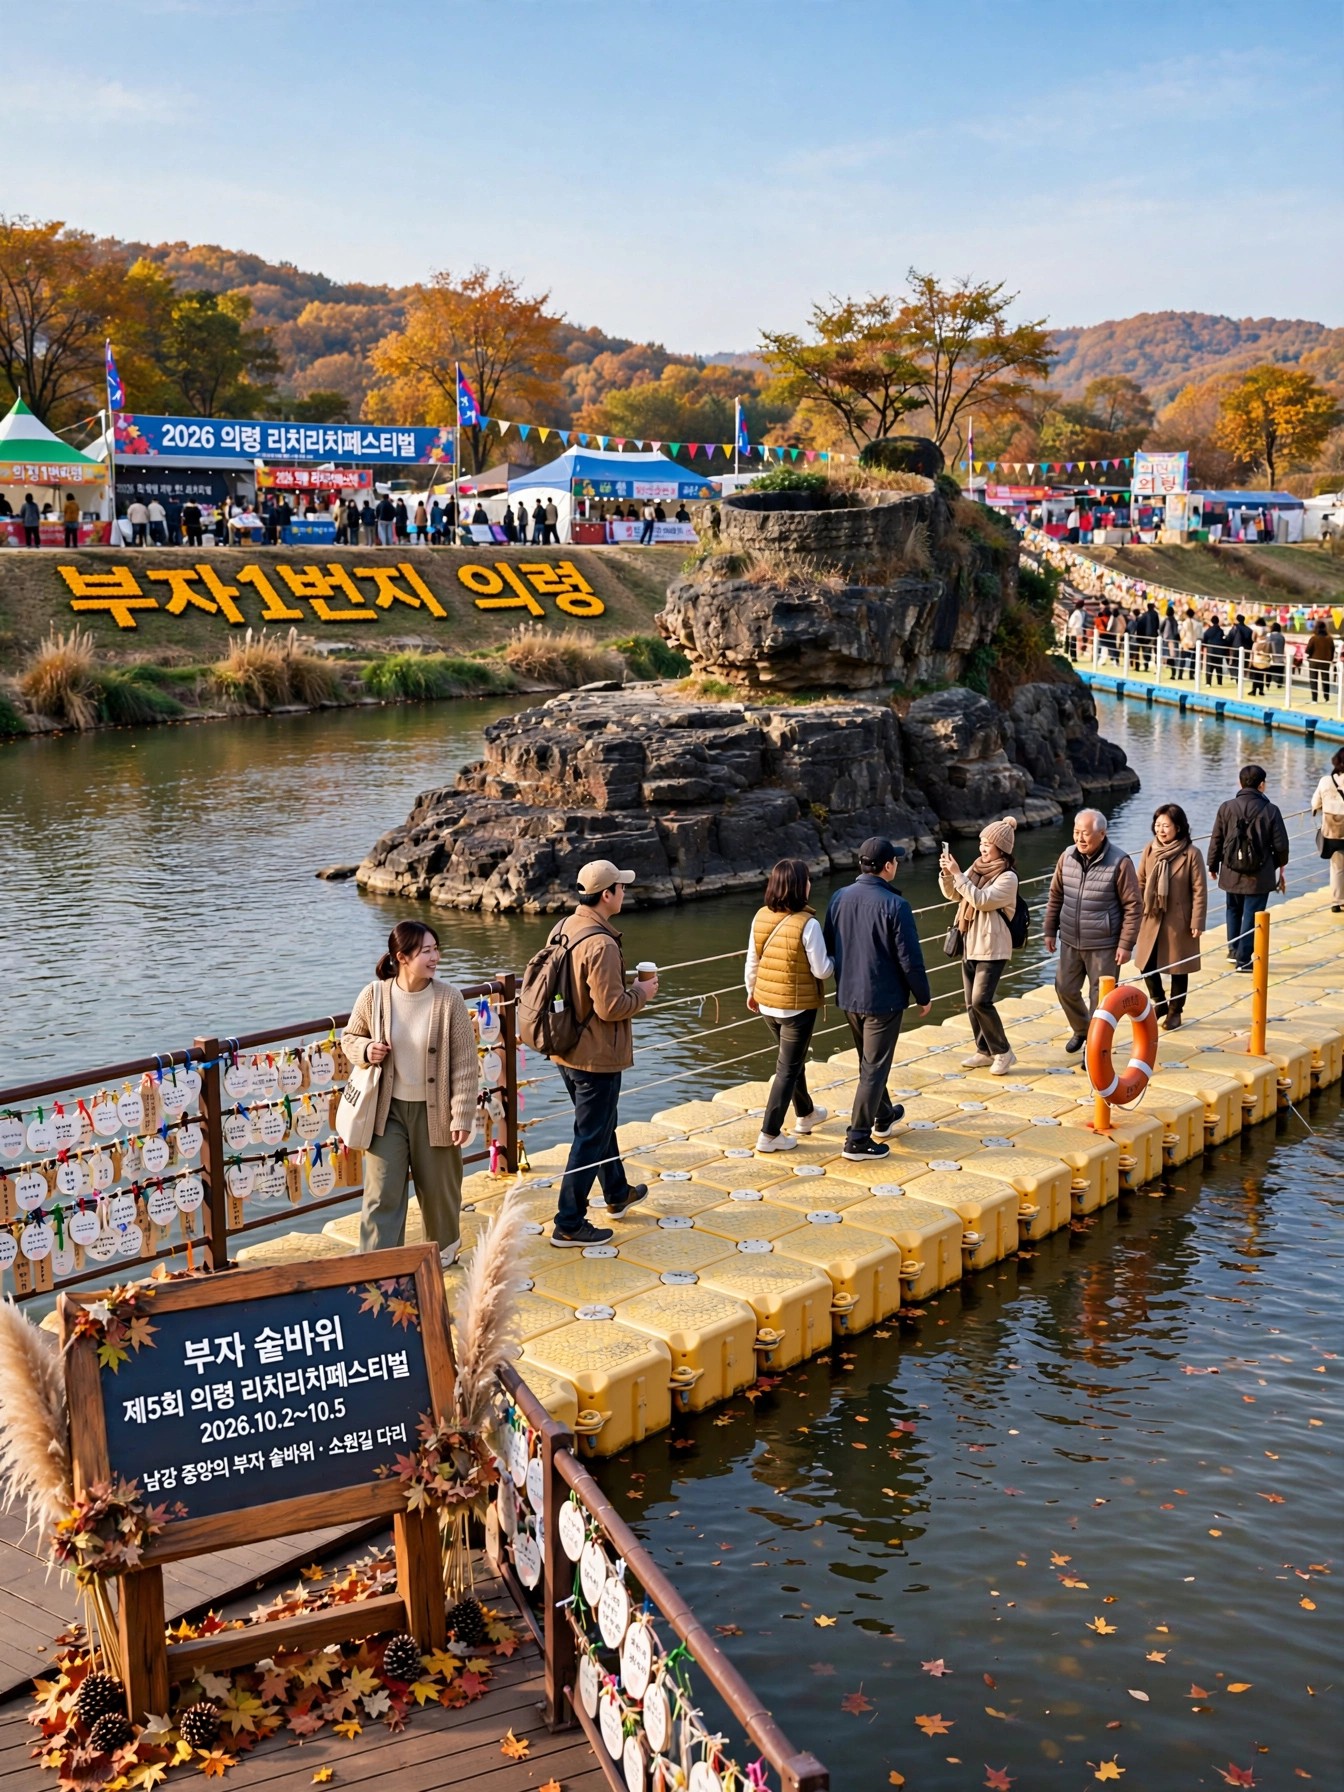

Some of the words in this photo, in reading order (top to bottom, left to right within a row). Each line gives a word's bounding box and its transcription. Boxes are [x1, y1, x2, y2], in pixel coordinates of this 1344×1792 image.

[162, 424, 214, 448] 2026
[220, 425, 261, 452] 의령
[268, 427, 416, 456] 리치리치페스티벌
[57, 564, 447, 627] 부자1번지
[457, 561, 605, 617] 의령
[184, 1332, 245, 1375] 부자
[254, 1315, 344, 1365] 솥바위
[123, 1390, 184, 1424] 제5회
[191, 1381, 235, 1412] 의령
[241, 1350, 410, 1403] 리치리치페스티벌
[200, 1398, 346, 1443] 2026.10.2~10.5
[143, 1467, 177, 1492] 남강
[181, 1457, 229, 1485] 중앙의
[233, 1451, 265, 1474] 부자
[269, 1441, 315, 1468] 솥바위
[328, 1430, 374, 1454] 소원길
[377, 1423, 407, 1446] 다리
